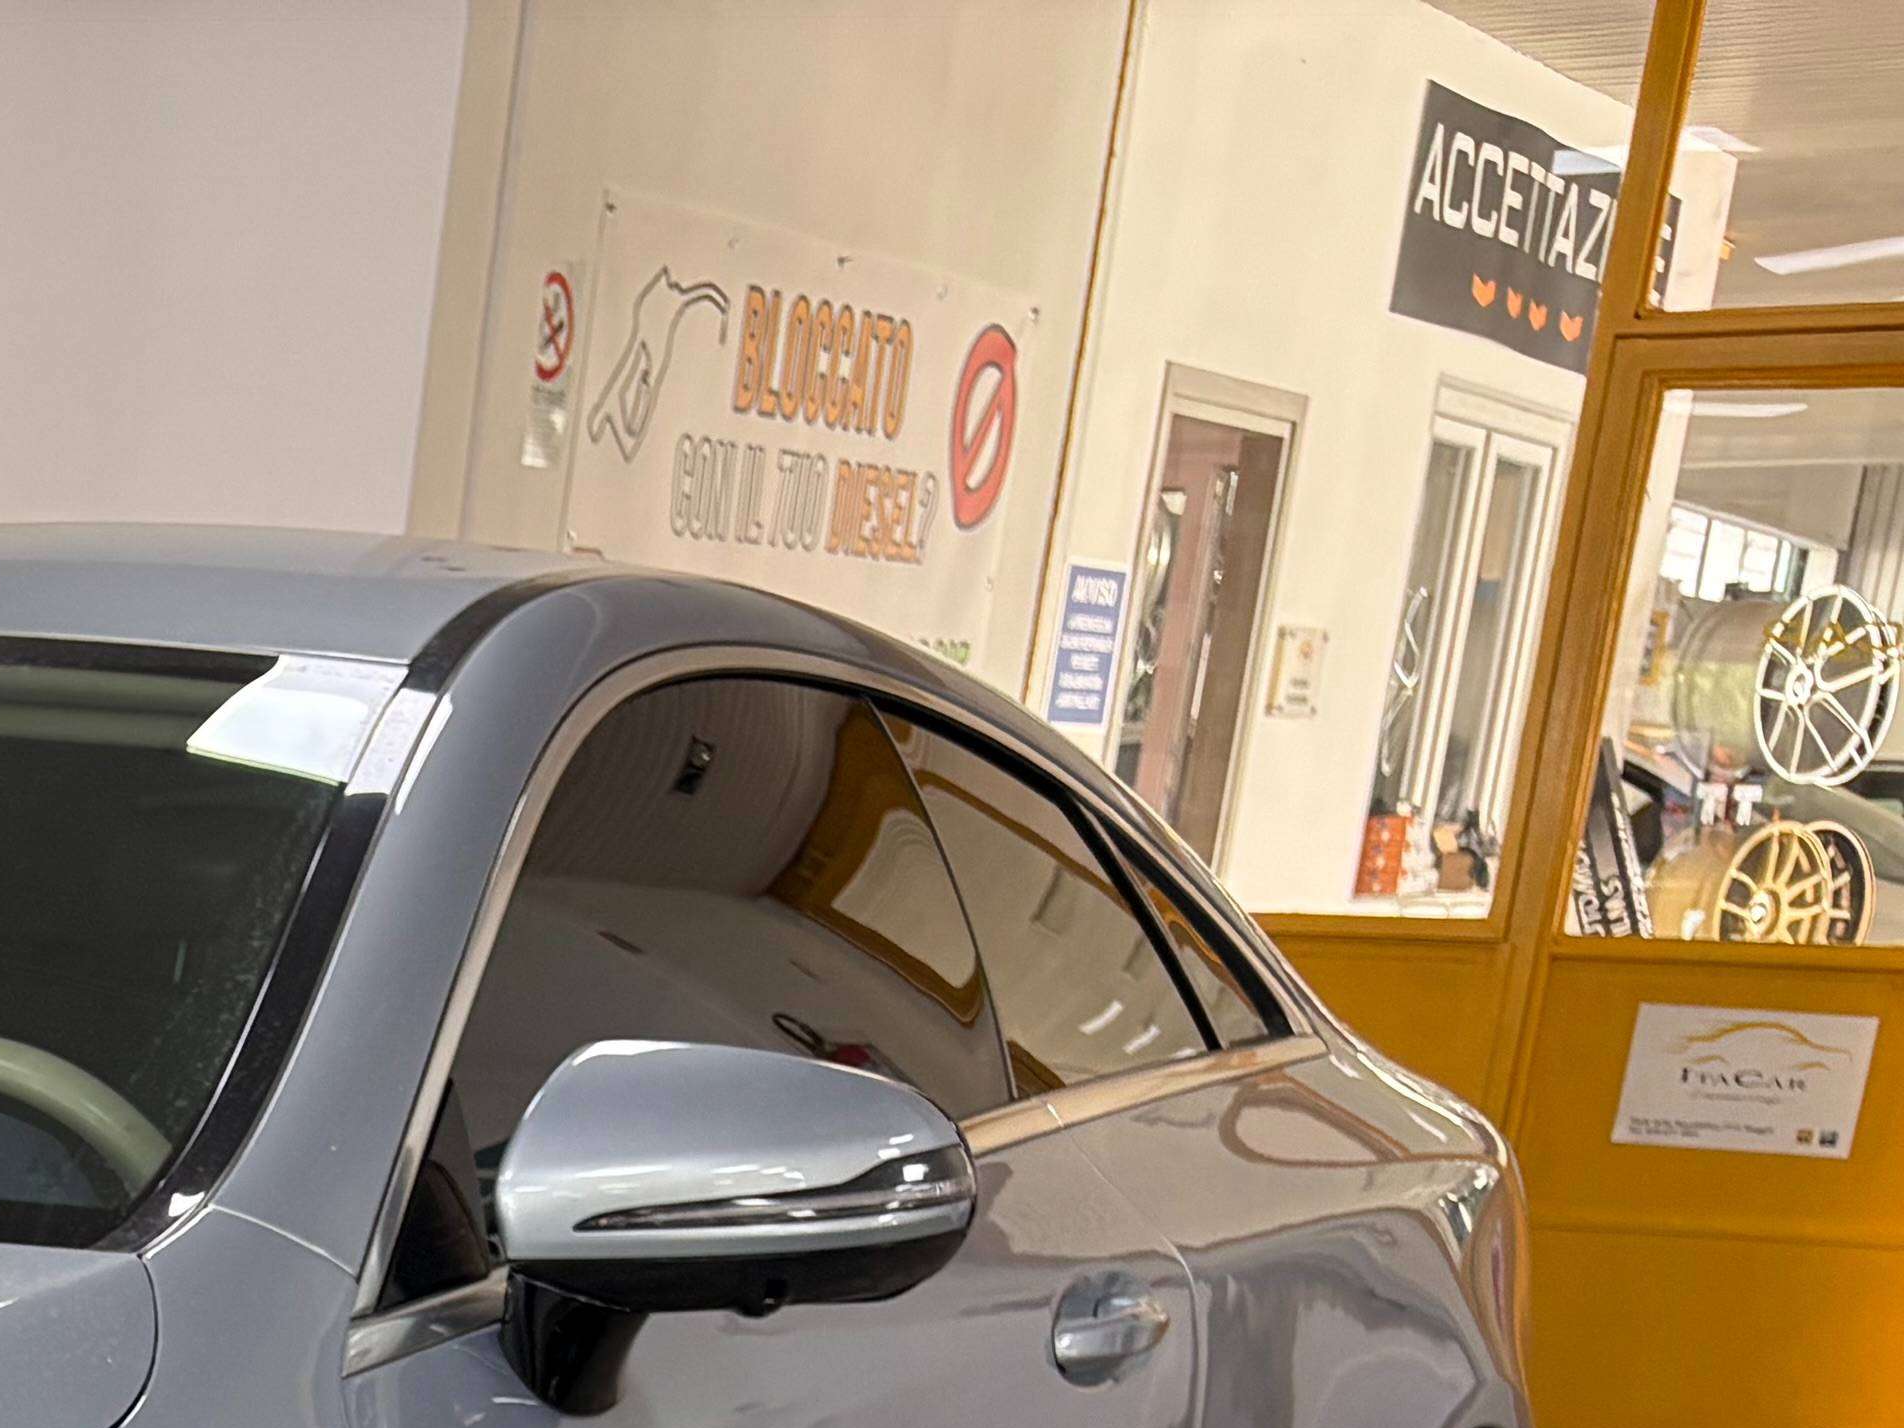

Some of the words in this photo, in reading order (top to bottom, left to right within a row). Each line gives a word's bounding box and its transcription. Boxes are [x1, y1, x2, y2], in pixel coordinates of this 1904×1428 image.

[733, 284, 913, 440] BLOCCATO
[670, 432, 738, 543] CON
[735, 442, 767, 546] IL
[767, 447, 829, 552] TUO
[824, 457, 940, 566] DIESEL?
